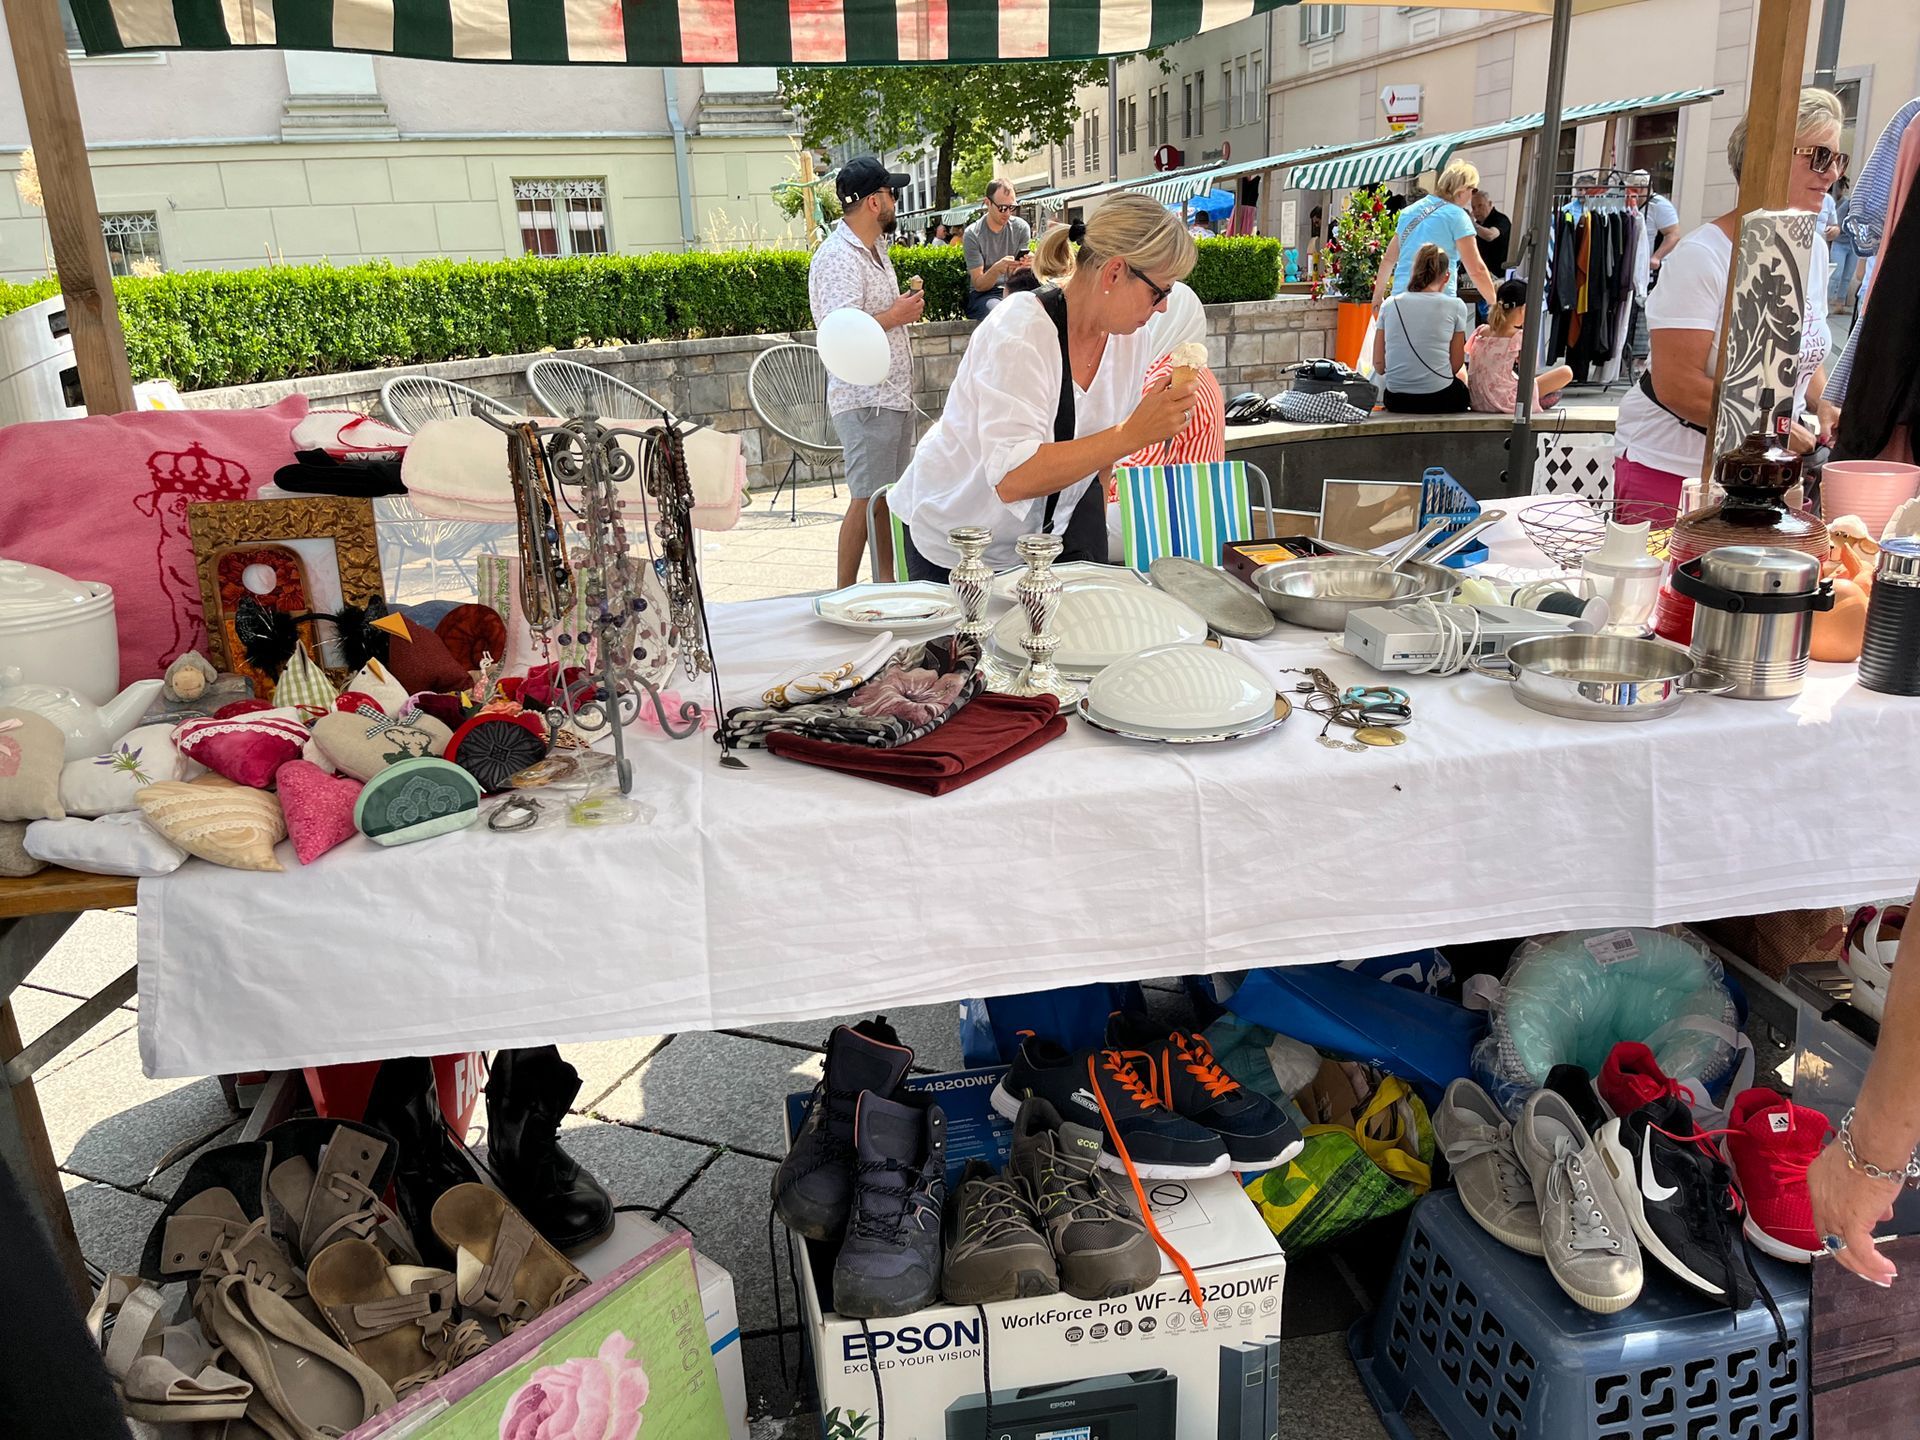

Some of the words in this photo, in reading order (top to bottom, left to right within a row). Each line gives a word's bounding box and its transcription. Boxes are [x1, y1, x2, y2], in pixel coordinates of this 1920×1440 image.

[1805, 338, 1826, 348] AND
[1799, 348, 1825, 363] RIES
[903, 1074, 997, 1093] F-4820DWF
[1070, 1091, 1101, 1113] Slazenge
[1077, 1138, 1099, 1149] ecco
[1001, 1306, 1093, 1330] WorkForce
[1098, 1301, 1128, 1317] Pro
[842, 1318, 980, 1361] EPSON
[844, 1360, 896, 1375] EXCED
[899, 1355, 935, 1367] YOUR
[938, 1348, 982, 1362] VISION
[1049, 1400, 1076, 1409] EPSON
